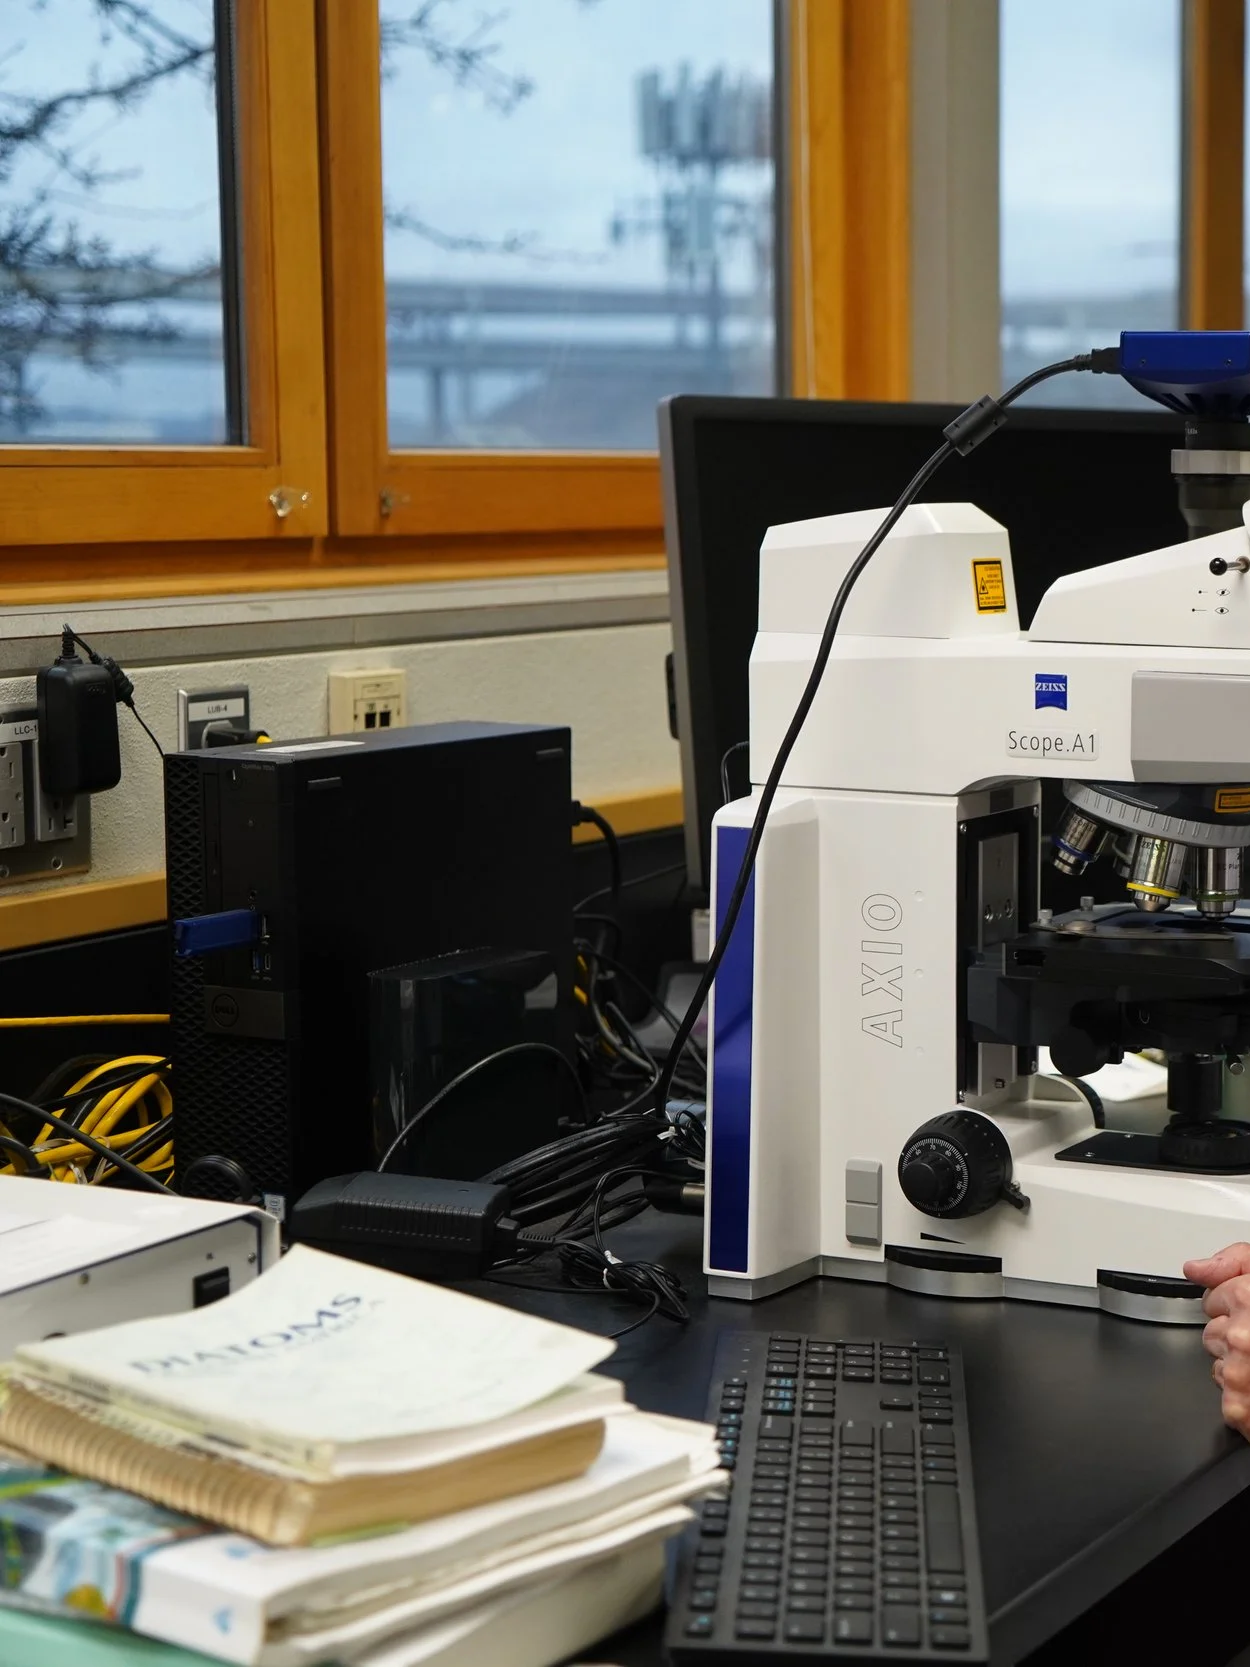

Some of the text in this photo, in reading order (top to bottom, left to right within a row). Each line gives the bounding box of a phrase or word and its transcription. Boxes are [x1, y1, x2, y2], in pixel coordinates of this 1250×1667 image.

[1035, 682, 1066, 692] ZEISS
[1008, 730, 1095, 757] Scope.A1
[861, 893, 903, 1048] AXIO
[129, 1293, 362, 1373] DIATOMS
